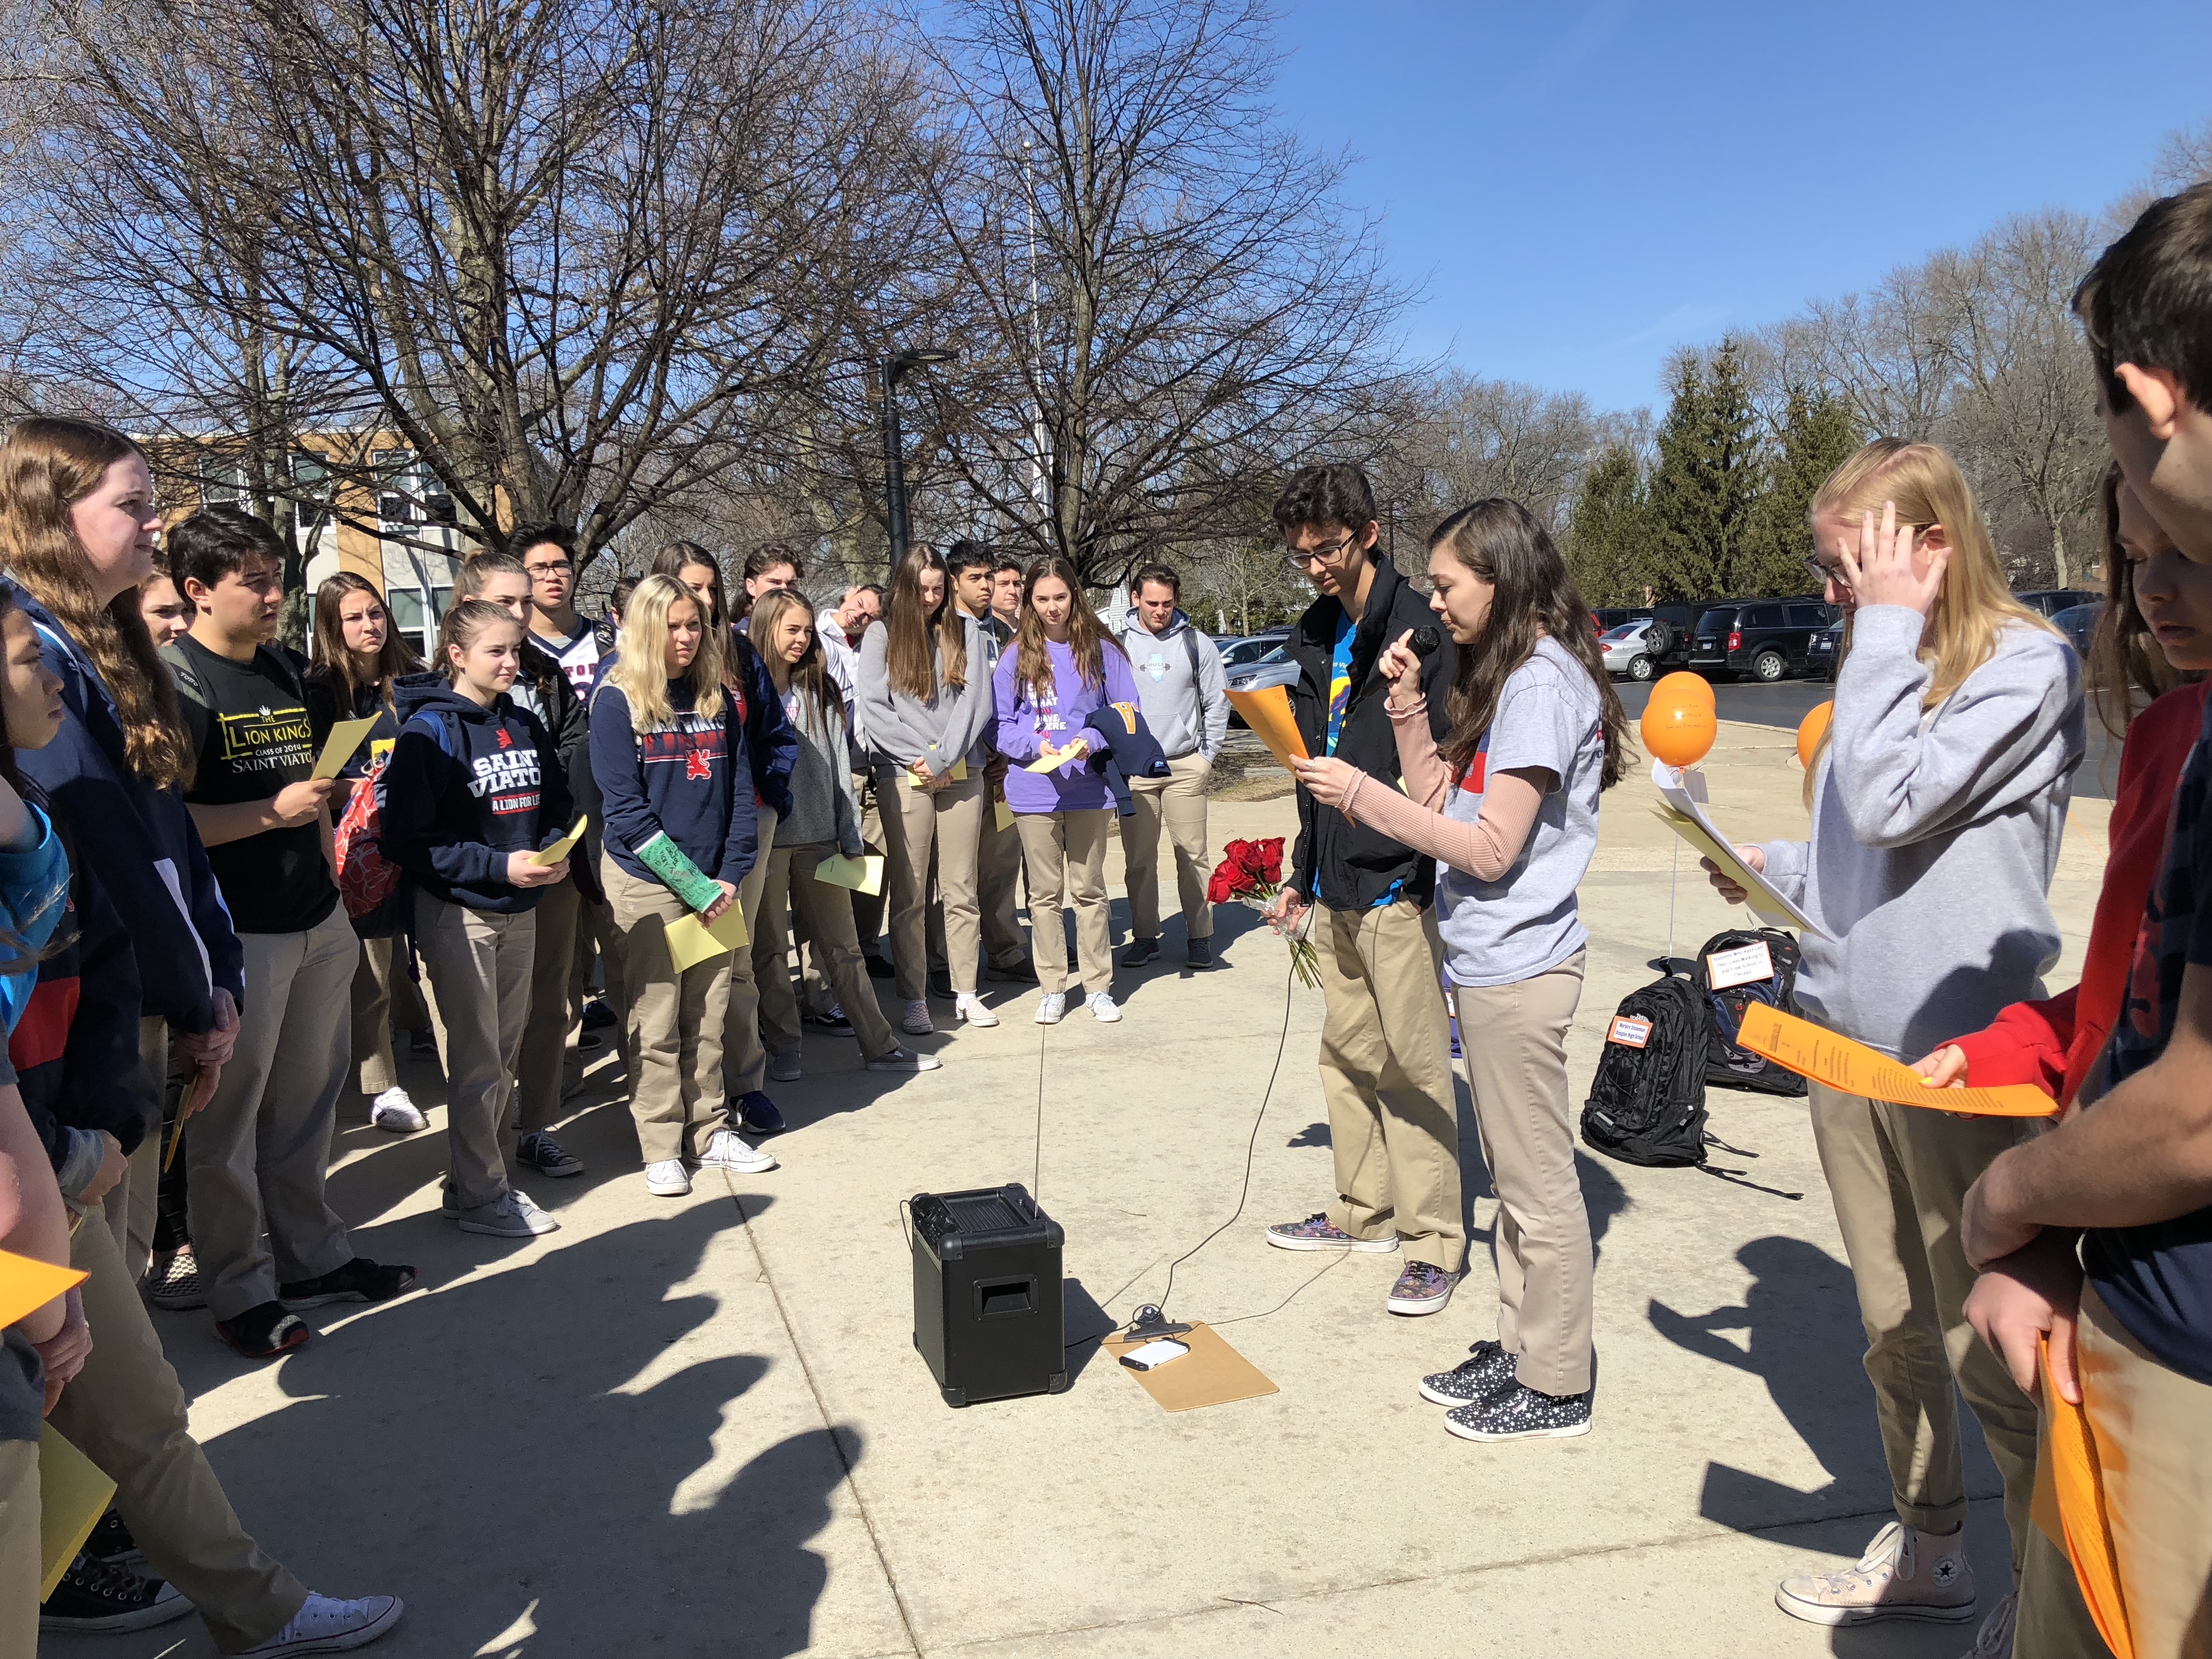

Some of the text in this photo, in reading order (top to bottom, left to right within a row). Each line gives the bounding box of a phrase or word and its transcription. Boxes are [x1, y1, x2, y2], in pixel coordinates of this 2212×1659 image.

[259, 715, 276, 723] THE
[229, 718, 311, 748] LION KINGS
[255, 748, 274, 757] CLASS
[284, 743, 302, 753] 2014
[232, 757, 278, 774] SAINT
[492, 800, 499, 811] A
[500, 798, 519, 810] LION
[518, 796, 532, 808] FOR
